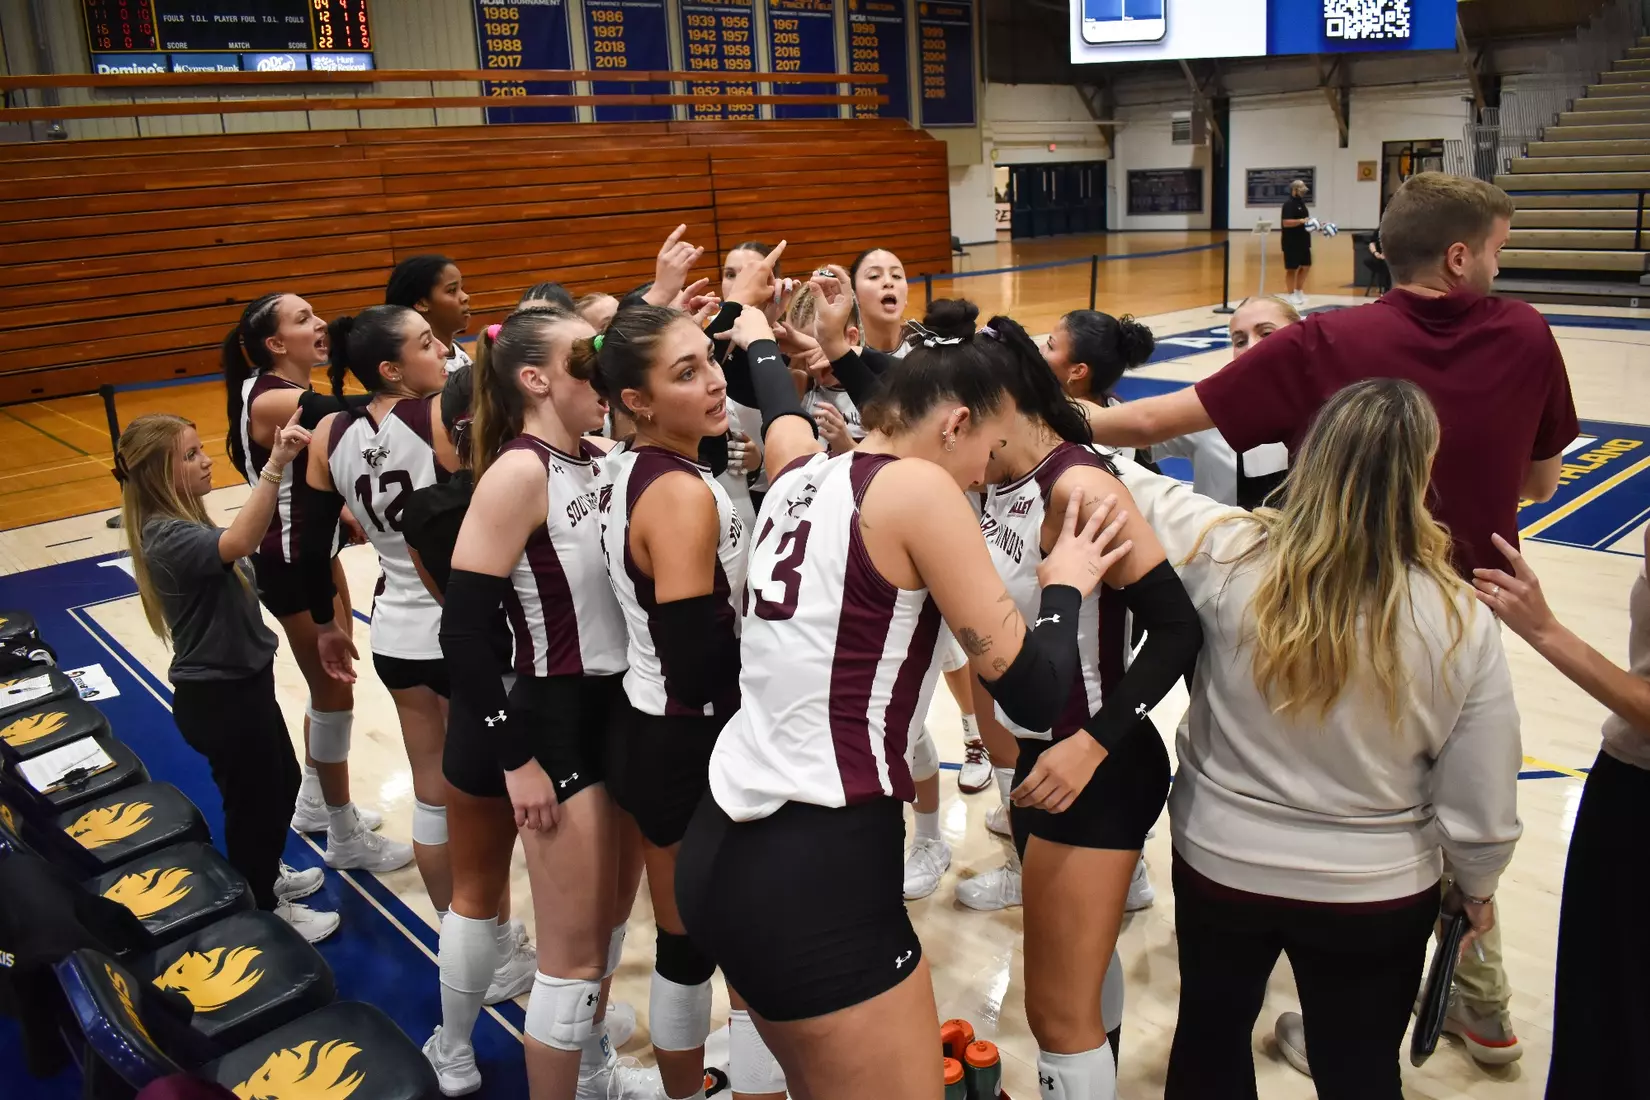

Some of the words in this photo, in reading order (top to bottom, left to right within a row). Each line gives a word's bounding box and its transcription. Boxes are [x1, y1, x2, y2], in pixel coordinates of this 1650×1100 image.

[163, 14, 184, 22] FOULS
[191, 15, 208, 23] T.O.L.
[214, 15, 238, 23] PLAYER
[241, 15, 256, 23] FOUL
[285, 16, 304, 24] FOULS
[319, 10, 330, 22] 12
[344, 12, 349, 21] 1
[358, 11, 366, 22] 6
[484, 7, 519, 20] 1986
[591, 10, 623, 22] 1986
[687, 15, 716, 27] 1939
[721, 16, 749, 28] 1956
[773, 19, 799, 31] 1967
[321, 24, 333, 36] 13
[345, 25, 350, 35] 1
[359, 24, 368, 36] 5
[484, 23, 520, 36] 1987
[593, 26, 623, 37] 1987
[688, 29, 717, 41] 1942
[722, 30, 749, 42] 1957
[318, 36, 333, 49] 22
[347, 37, 352, 48] 1
[361, 37, 369, 49] 5
[773, 32, 800, 44] 2015
[852, 36, 878, 47] 2003
[486, 39, 522, 52] 1988
[594, 41, 625, 53] 2018
[689, 44, 717, 55] 1947
[722, 45, 751, 56] 1958
[774, 46, 800, 58] 2016
[853, 49, 879, 60] 2004
[487, 55, 522, 68] 2017
[595, 56, 627, 68] 2019
[690, 58, 719, 70] 1948
[723, 58, 751, 70] 1959
[775, 60, 800, 71] 2017
[98, 62, 166, 75] Domino's
[182, 65, 215, 73] Cypress
[216, 65, 239, 73] Bank
[491, 86, 527, 97] 2019
[692, 86, 721, 96] 1952
[725, 86, 754, 96] 1964
[355, 469, 415, 533] 12
